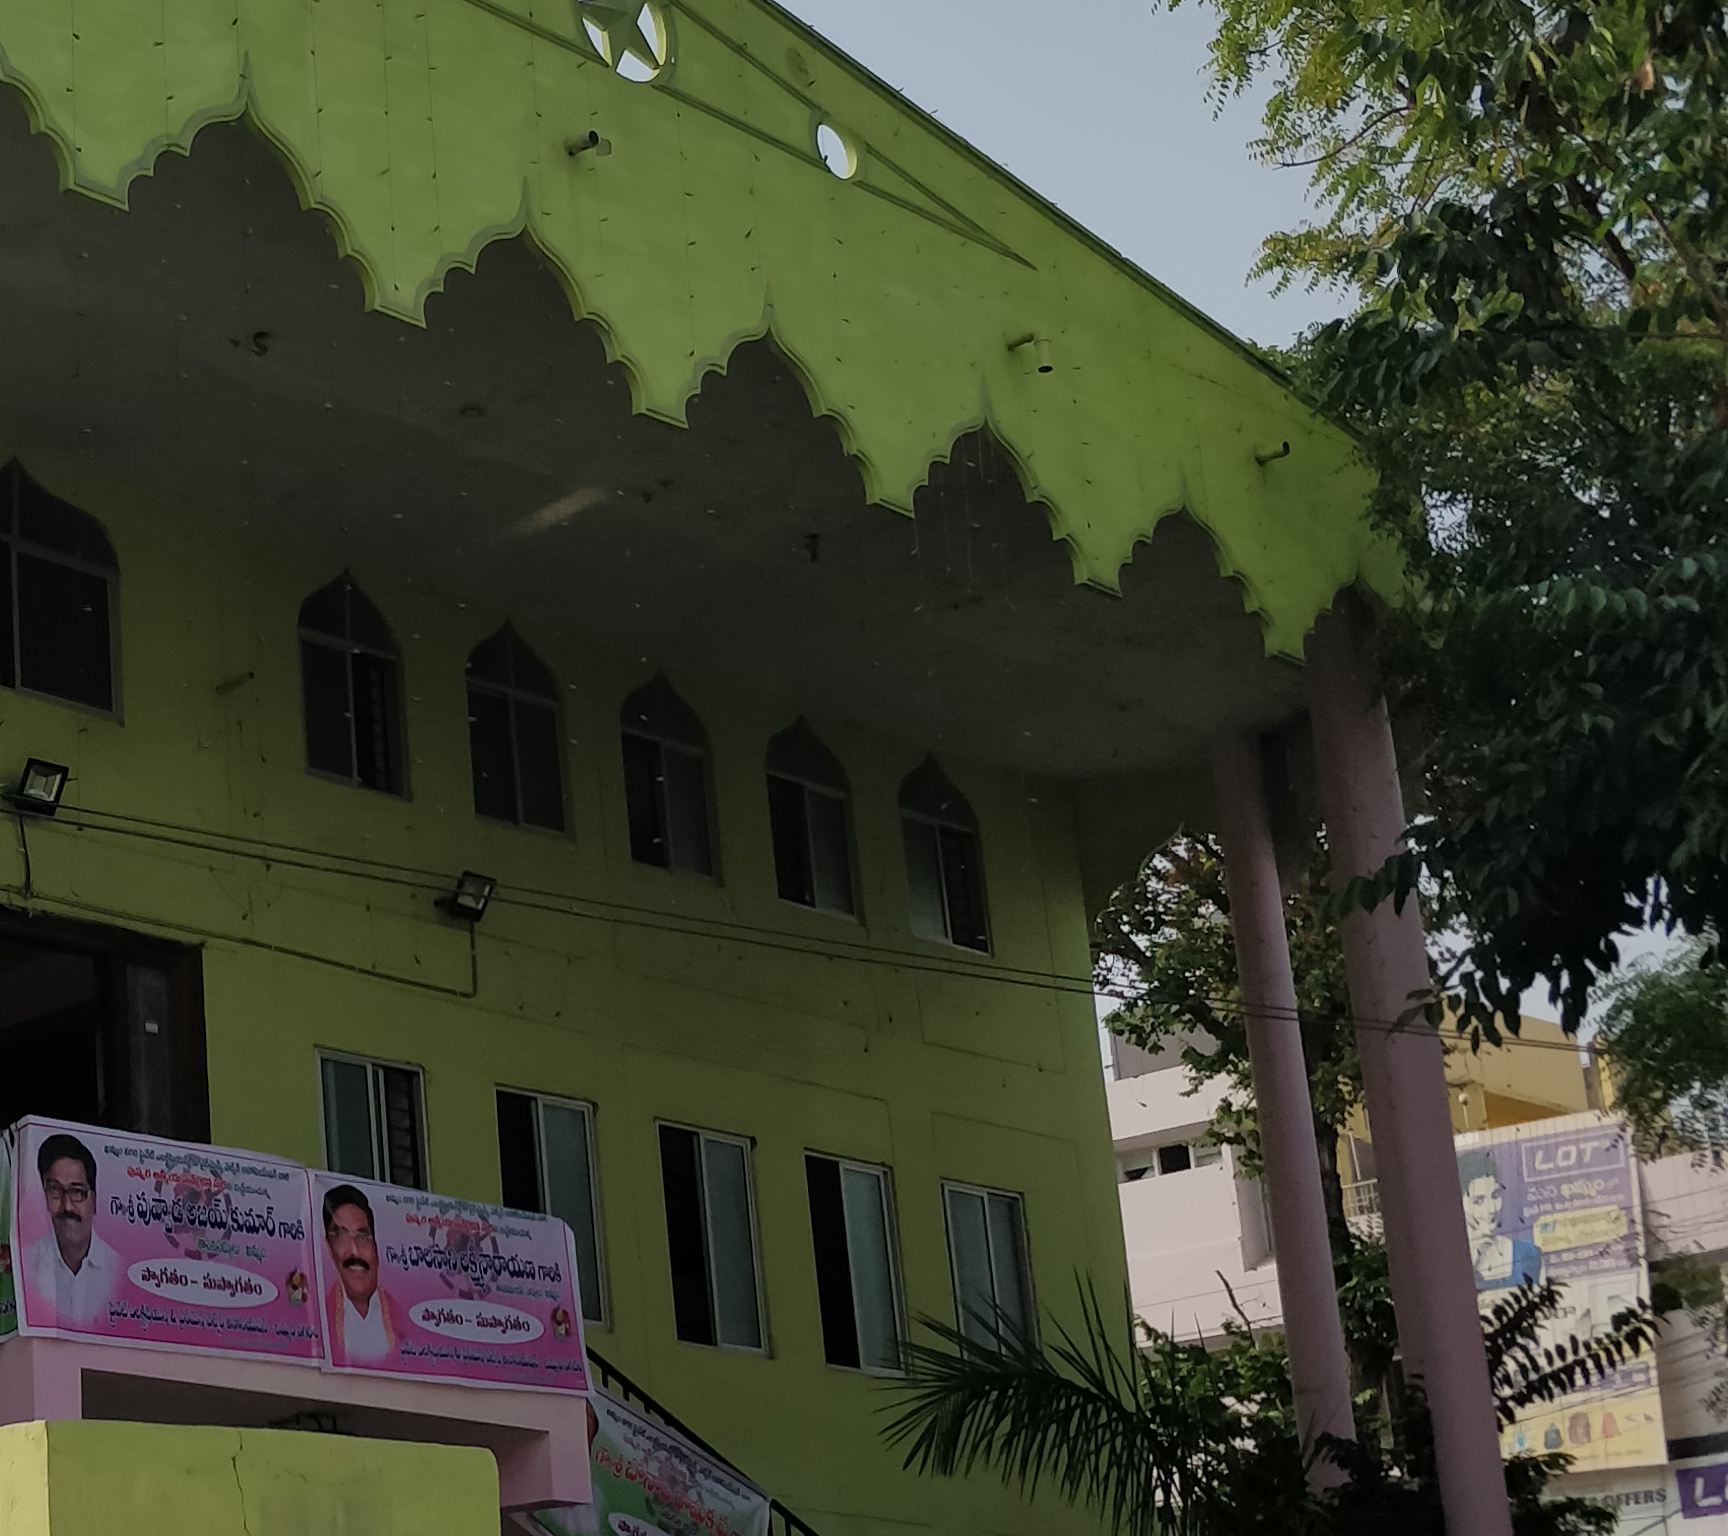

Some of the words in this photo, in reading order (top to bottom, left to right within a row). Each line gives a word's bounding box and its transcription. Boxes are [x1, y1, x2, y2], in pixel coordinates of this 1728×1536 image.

[1534, 1141, 1600, 1171] LOT
[185, 1197, 228, 1230] అజయ్
[230, 1206, 276, 1238] కుమార్
[141, 1266, 189, 1288] స్వాగతం
